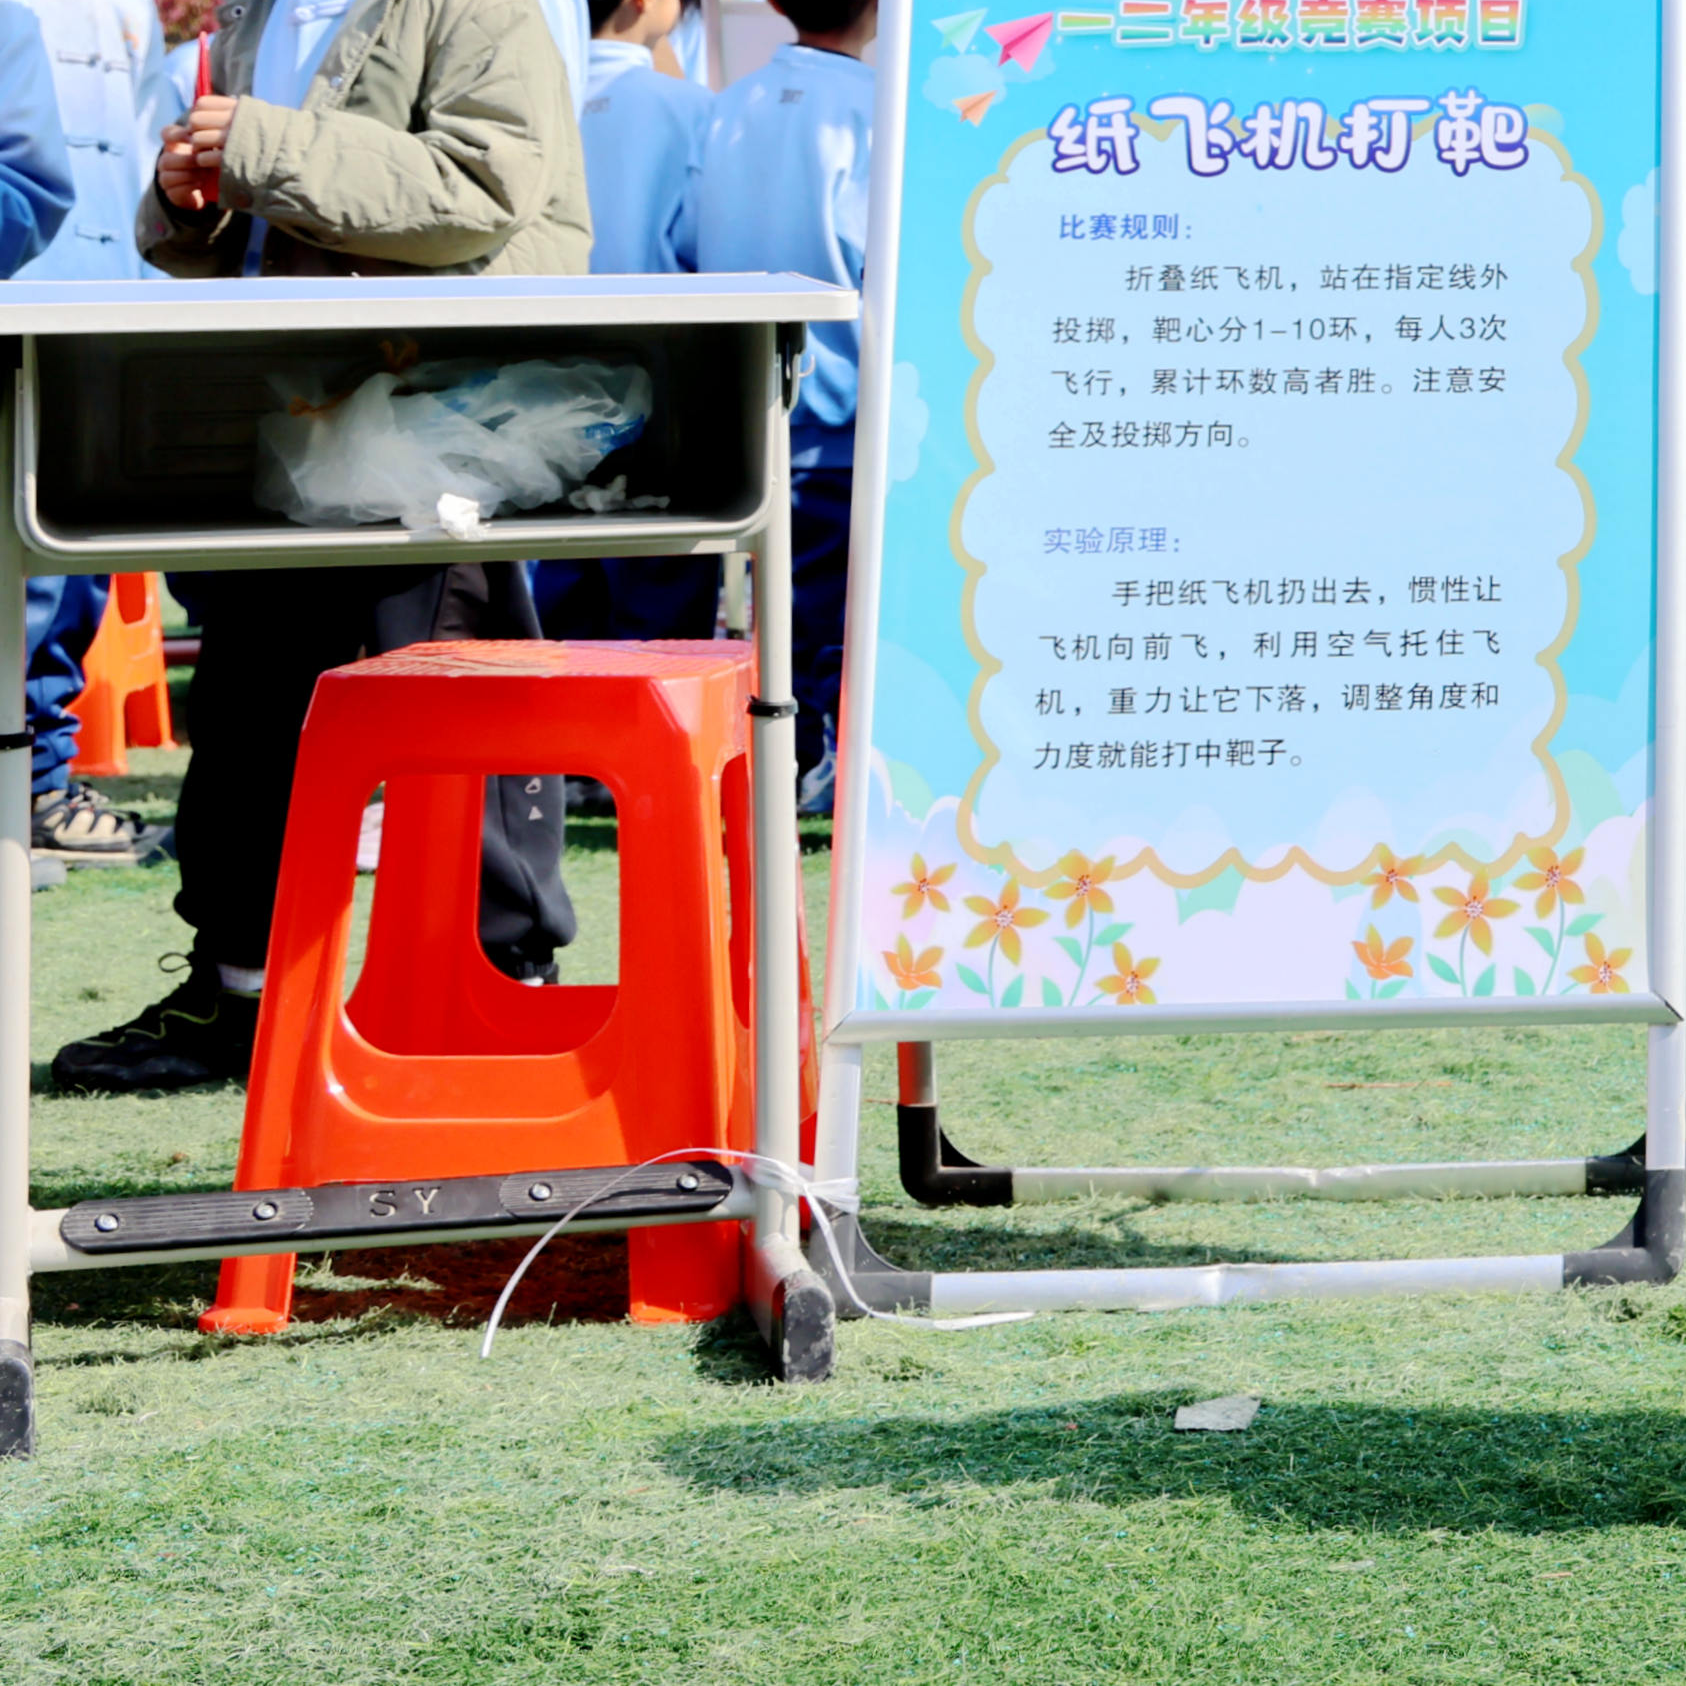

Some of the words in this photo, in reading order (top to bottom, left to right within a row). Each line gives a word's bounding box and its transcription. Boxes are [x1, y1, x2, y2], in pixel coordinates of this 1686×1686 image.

[1047, 86, 1529, 177] 纸飞机打靶
[1059, 213, 1192, 241] 比赛规则：
[1124, 263, 1509, 293] 折叠纸飞机，站在指定线外
[1050, 366, 1507, 397] 飞行，累计环数高者胜。注意安
[1047, 420, 1250, 449] 全及投掷方向。
[1043, 526, 1180, 555] 实验原理：
[1111, 575, 1503, 607] 手把纸飞机扔出去，惯性让
[1038, 628, 1501, 661] 飞机向前飞，利用空气托住飞
[1034, 682, 1499, 716] 机，重力让它下落，调整角度和
[1033, 738, 1303, 770] 力度就能打中靶子。
[369, 1186, 442, 1218] SY
